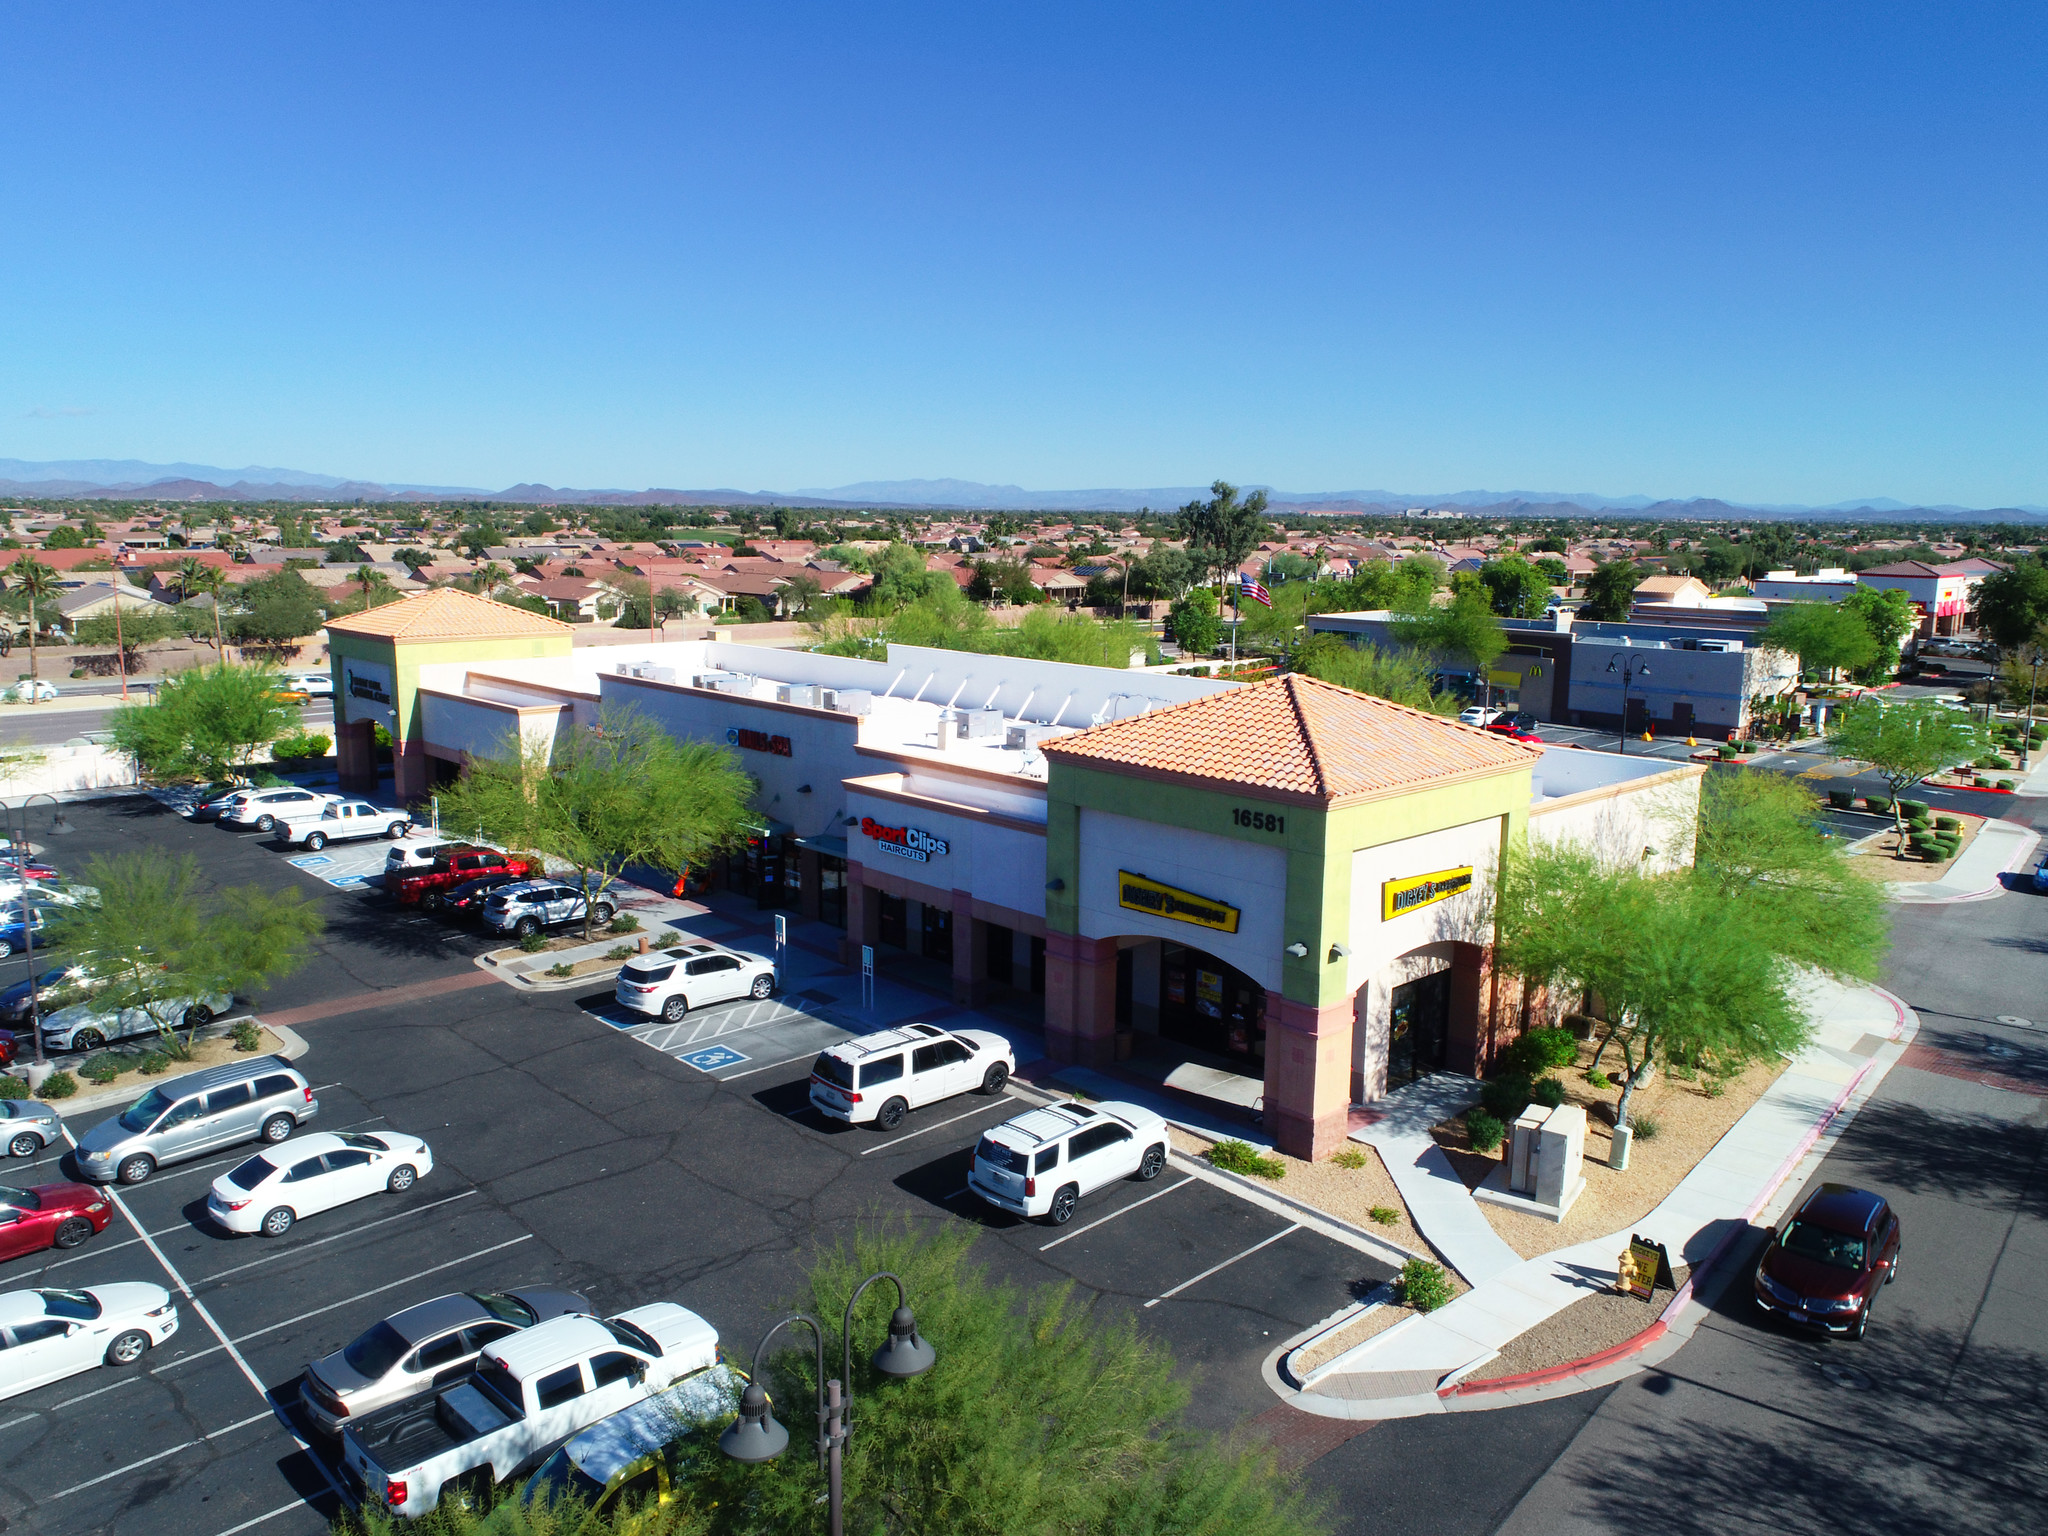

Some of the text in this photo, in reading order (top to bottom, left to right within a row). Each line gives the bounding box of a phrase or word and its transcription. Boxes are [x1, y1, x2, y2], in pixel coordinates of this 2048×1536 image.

[1232, 808, 1285, 834] 16581
[880, 842, 925, 861] HAIRCUTS
[1394, 881, 1437, 911] DICKEY'S
[1636, 1259, 1649, 1273] WE
[1630, 1272, 1652, 1287] ATER
